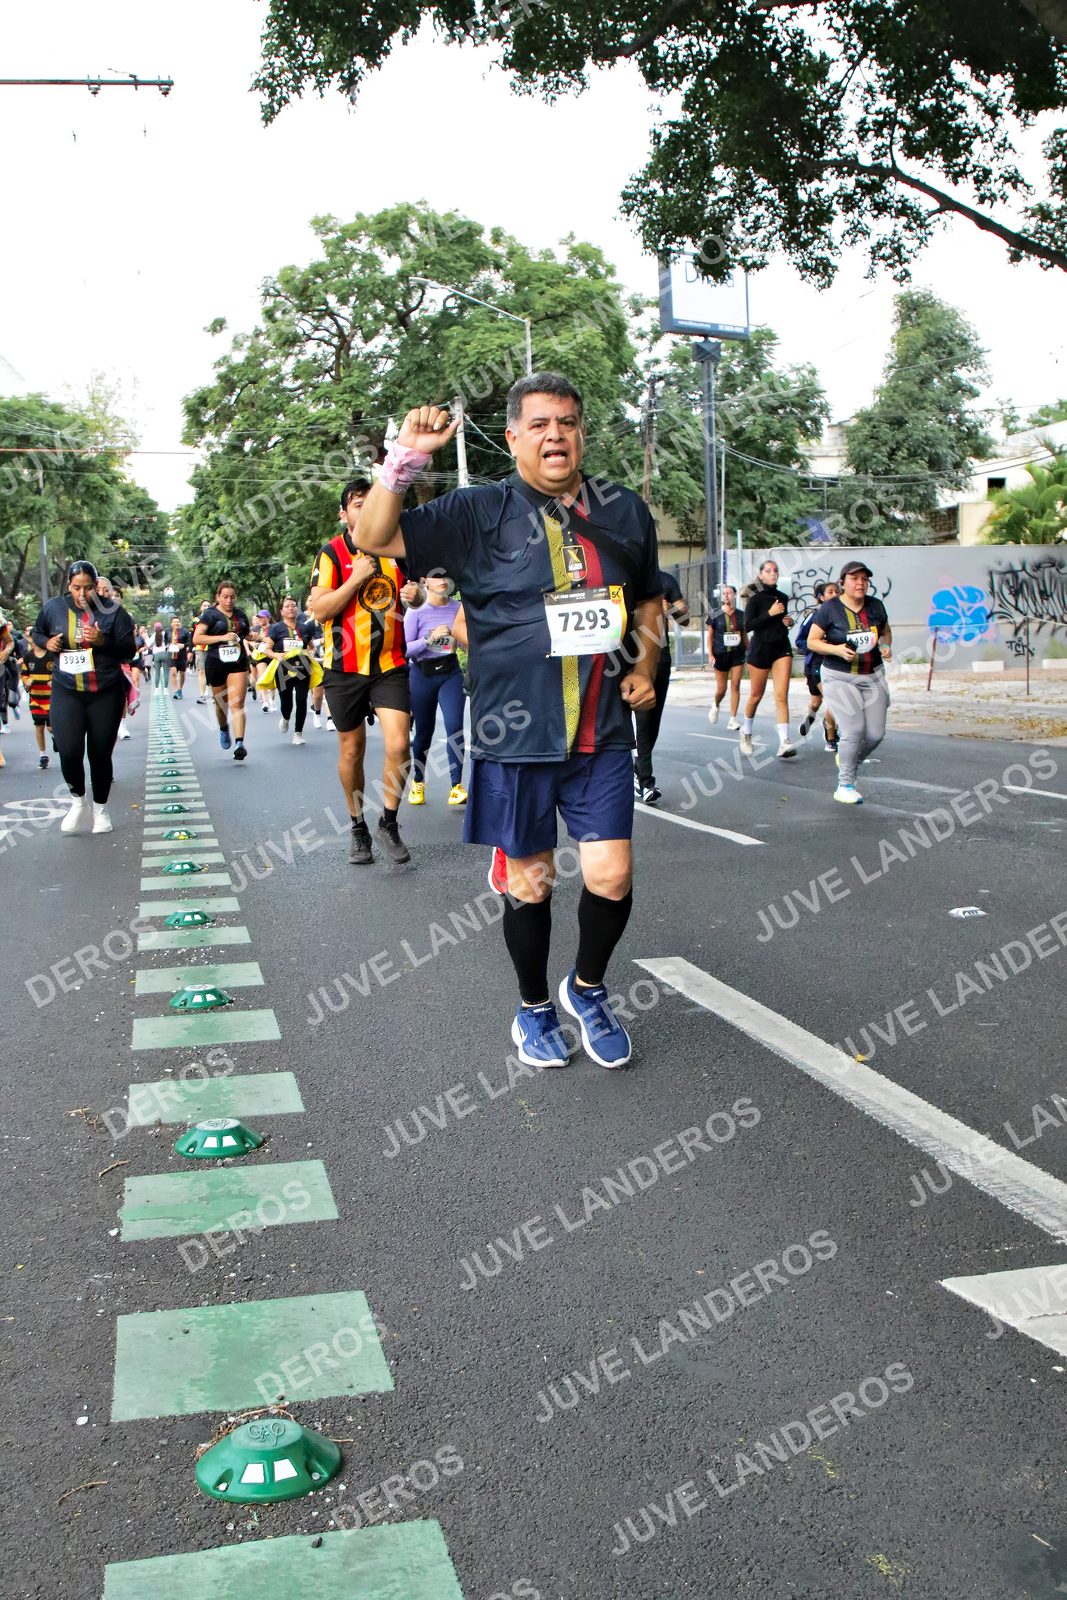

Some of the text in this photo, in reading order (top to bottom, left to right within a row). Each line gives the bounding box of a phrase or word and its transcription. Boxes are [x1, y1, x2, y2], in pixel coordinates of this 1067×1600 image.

[793, 566, 834, 582] TOY
[558, 608, 611, 632] 7293
[222, 648, 238, 656] 7364
[64, 655, 86, 665] 3939
